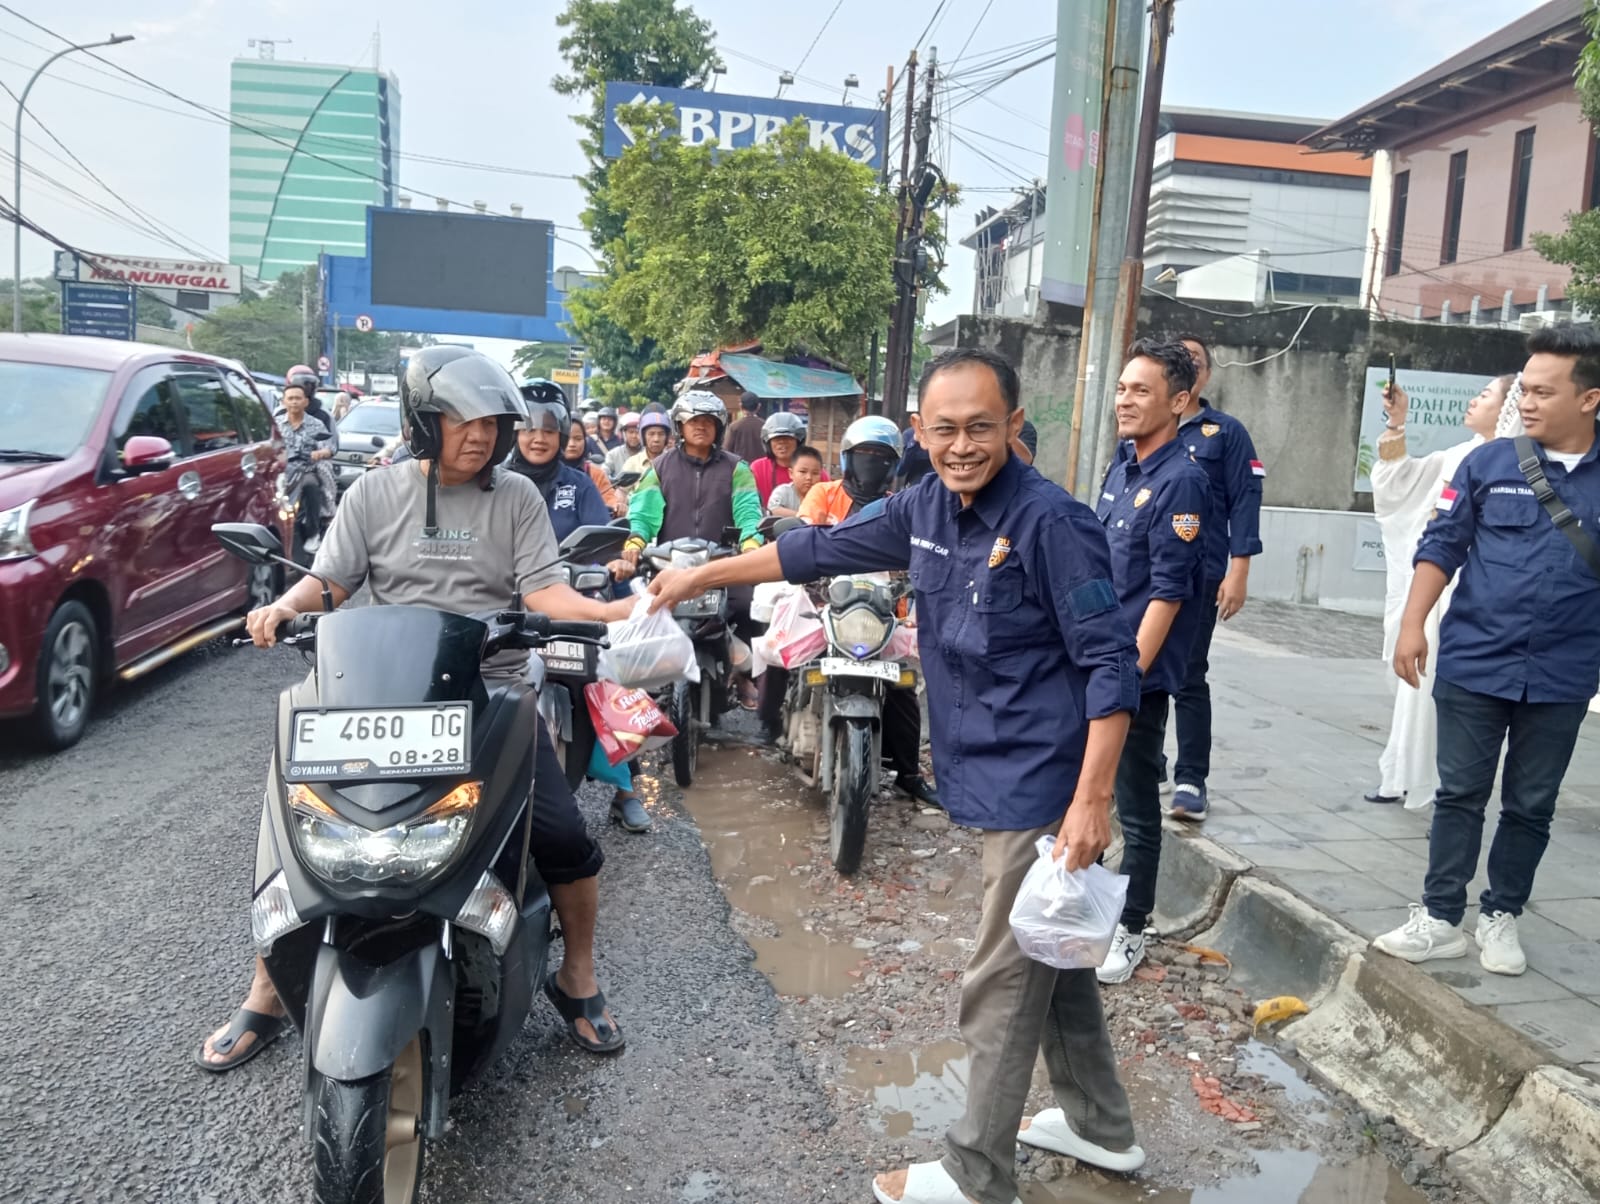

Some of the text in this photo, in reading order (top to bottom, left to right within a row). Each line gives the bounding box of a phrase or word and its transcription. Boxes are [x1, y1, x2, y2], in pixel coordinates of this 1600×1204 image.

[174, 263, 224, 273] MOBIL
[89, 268, 231, 290] MANUNGGAL
[299, 713, 462, 743] E 4660 DG
[301, 765, 338, 776] YAMAHA
